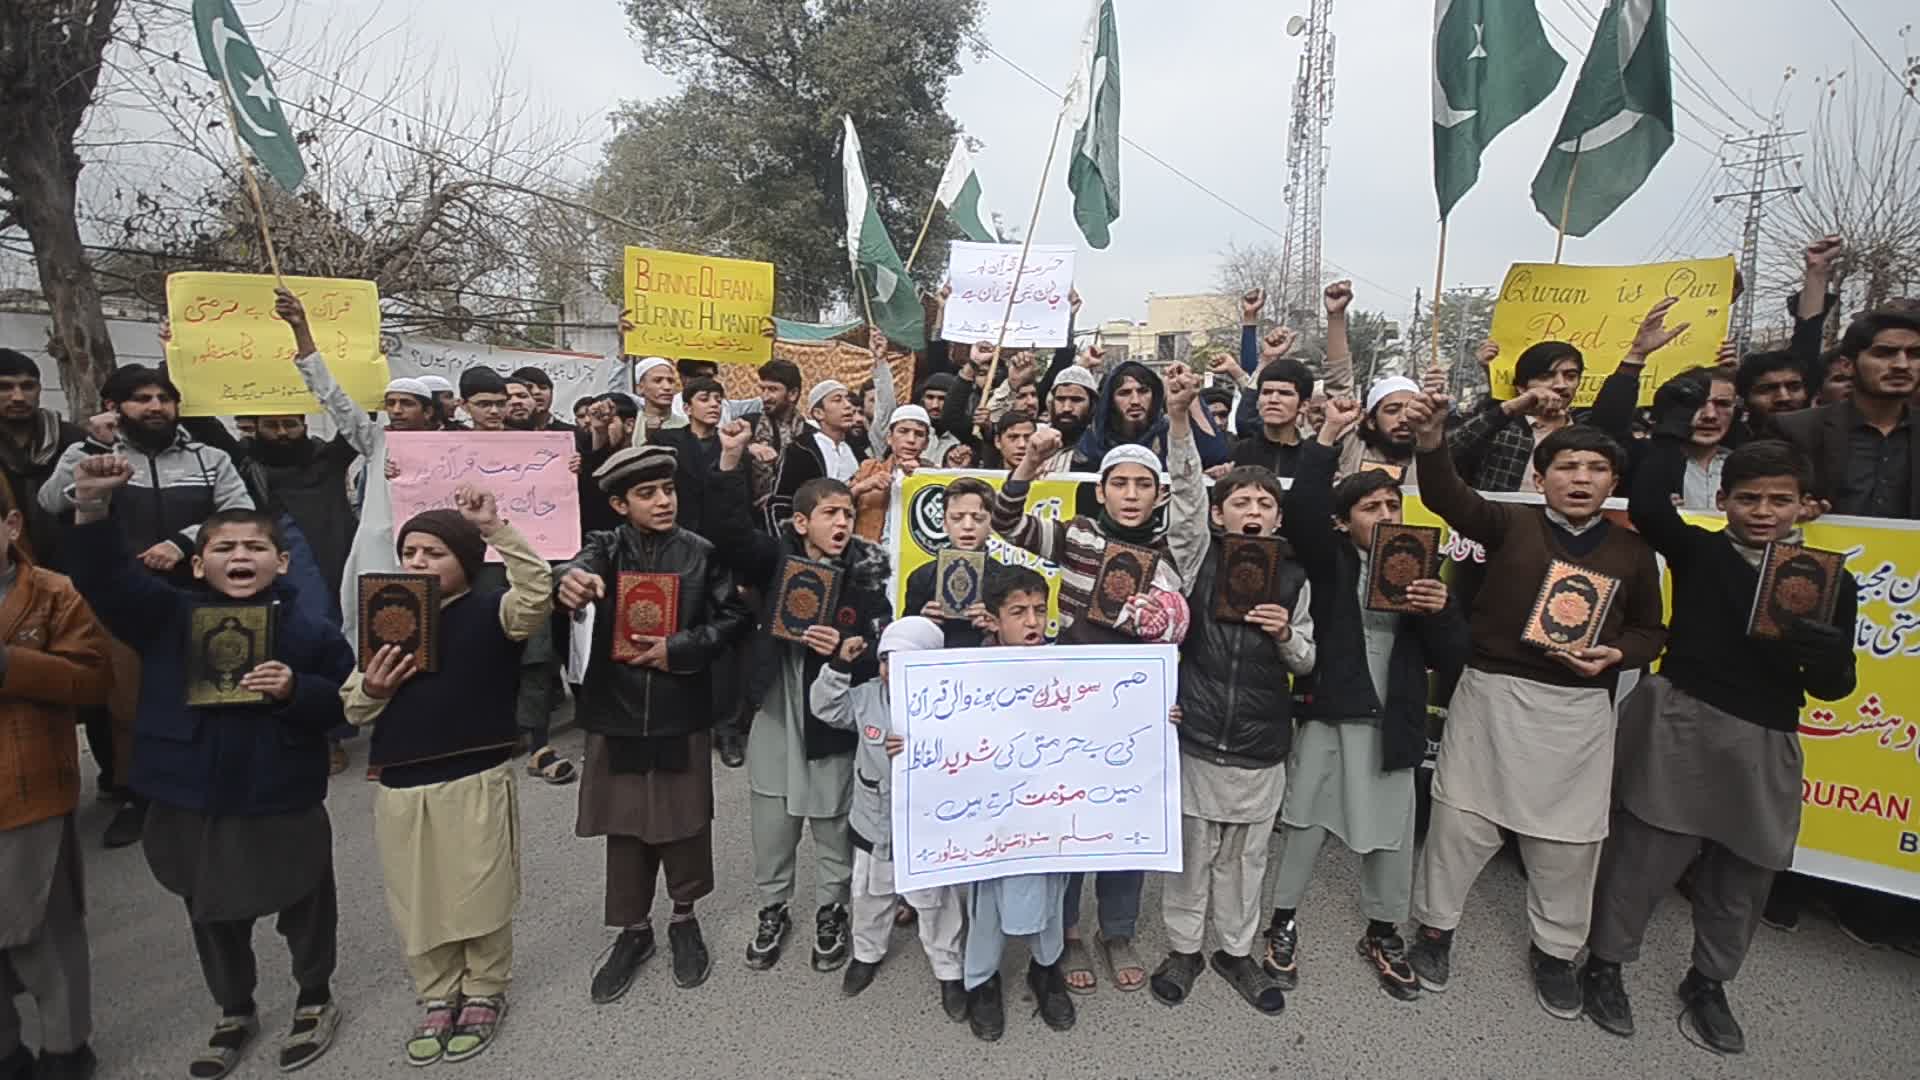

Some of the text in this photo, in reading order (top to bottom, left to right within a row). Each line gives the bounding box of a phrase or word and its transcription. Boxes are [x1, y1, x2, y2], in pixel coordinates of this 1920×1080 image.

[1503, 268, 1721, 305] Quran is Our
[1525, 312, 1609, 350] Red
[997, 683, 1036, 707] میں
[940, 737, 997, 775] شدید
[993, 731, 1028, 770] کی
[1104, 725, 1153, 766] کی
[986, 781, 1028, 818] کرتے
[1088, 784, 1143, 804] میں
